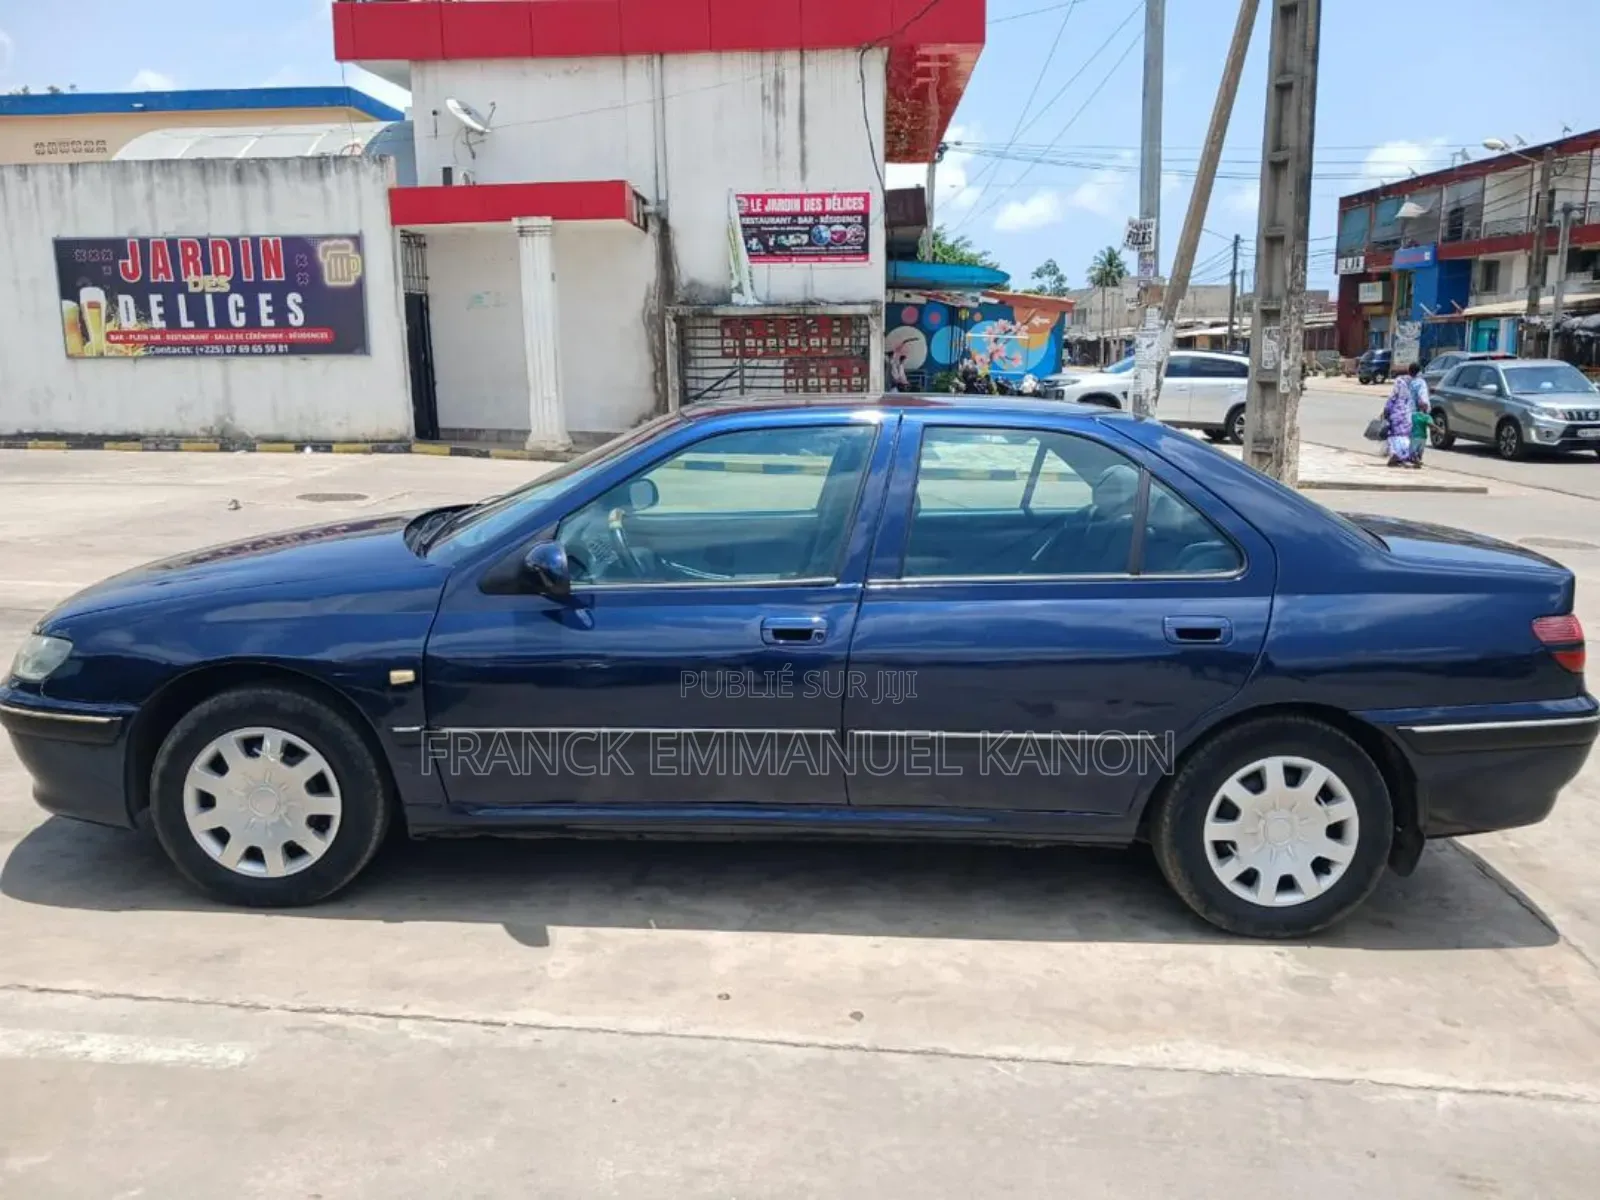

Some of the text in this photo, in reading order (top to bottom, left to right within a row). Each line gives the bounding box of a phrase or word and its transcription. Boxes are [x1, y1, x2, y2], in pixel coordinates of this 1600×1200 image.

[750, 198, 762, 212] LE
[764, 198, 801, 212] JARDIN
[803, 198, 823, 212] DES
[824, 194, 865, 212] DÉLICES
[741, 216, 792, 225] RESTAURANT
[798, 215, 814, 224] BAR
[118, 236, 285, 283] JARDIN
[185, 275, 231, 293] DES
[117, 291, 305, 329] DELICES
[165, 333, 210, 341] RESTAURANT
[149, 345, 193, 355] Contacts:
[195, 345, 224, 355] (+225)
[225, 345, 236, 353] 07
